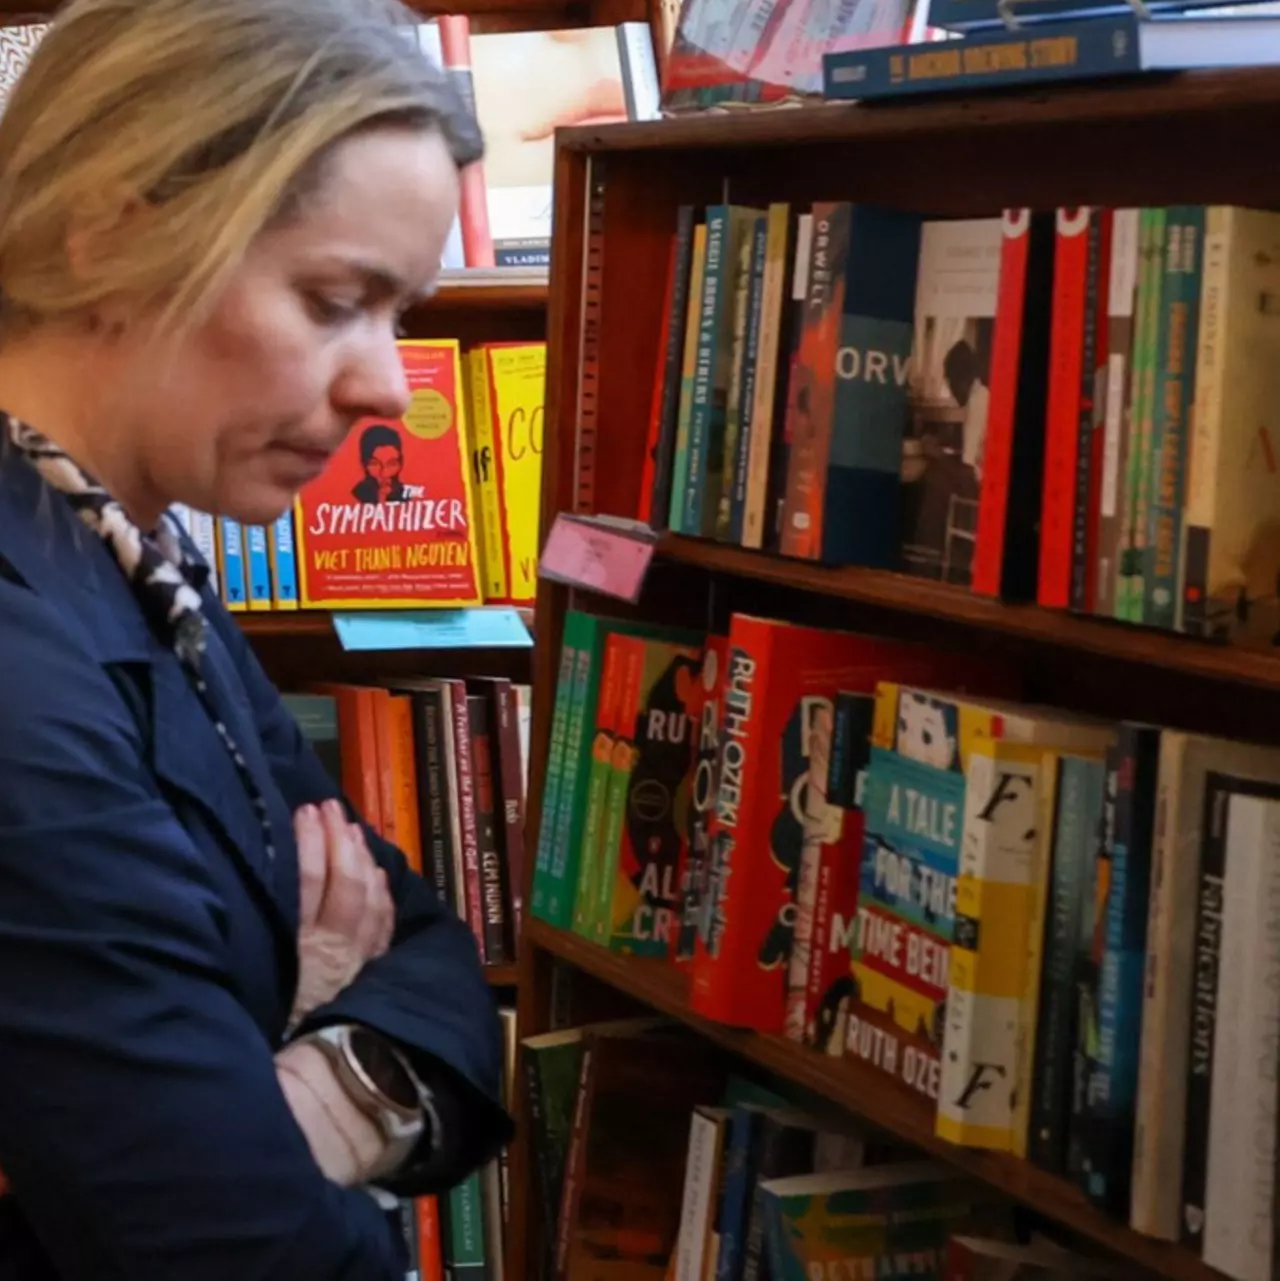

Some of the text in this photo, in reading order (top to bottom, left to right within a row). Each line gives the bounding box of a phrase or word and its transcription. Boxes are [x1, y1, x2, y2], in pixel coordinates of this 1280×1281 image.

[812, 220, 829, 308] ORWELL
[308, 499, 468, 536] SYMPATHIZER
[402, 484, 426, 499] THE
[312, 540, 469, 572] VIET THANH NGUYEN
[717, 655, 757, 828] RUTH OZEKI
[887, 786, 956, 847] A TALE
[858, 909, 901, 966] TIME
